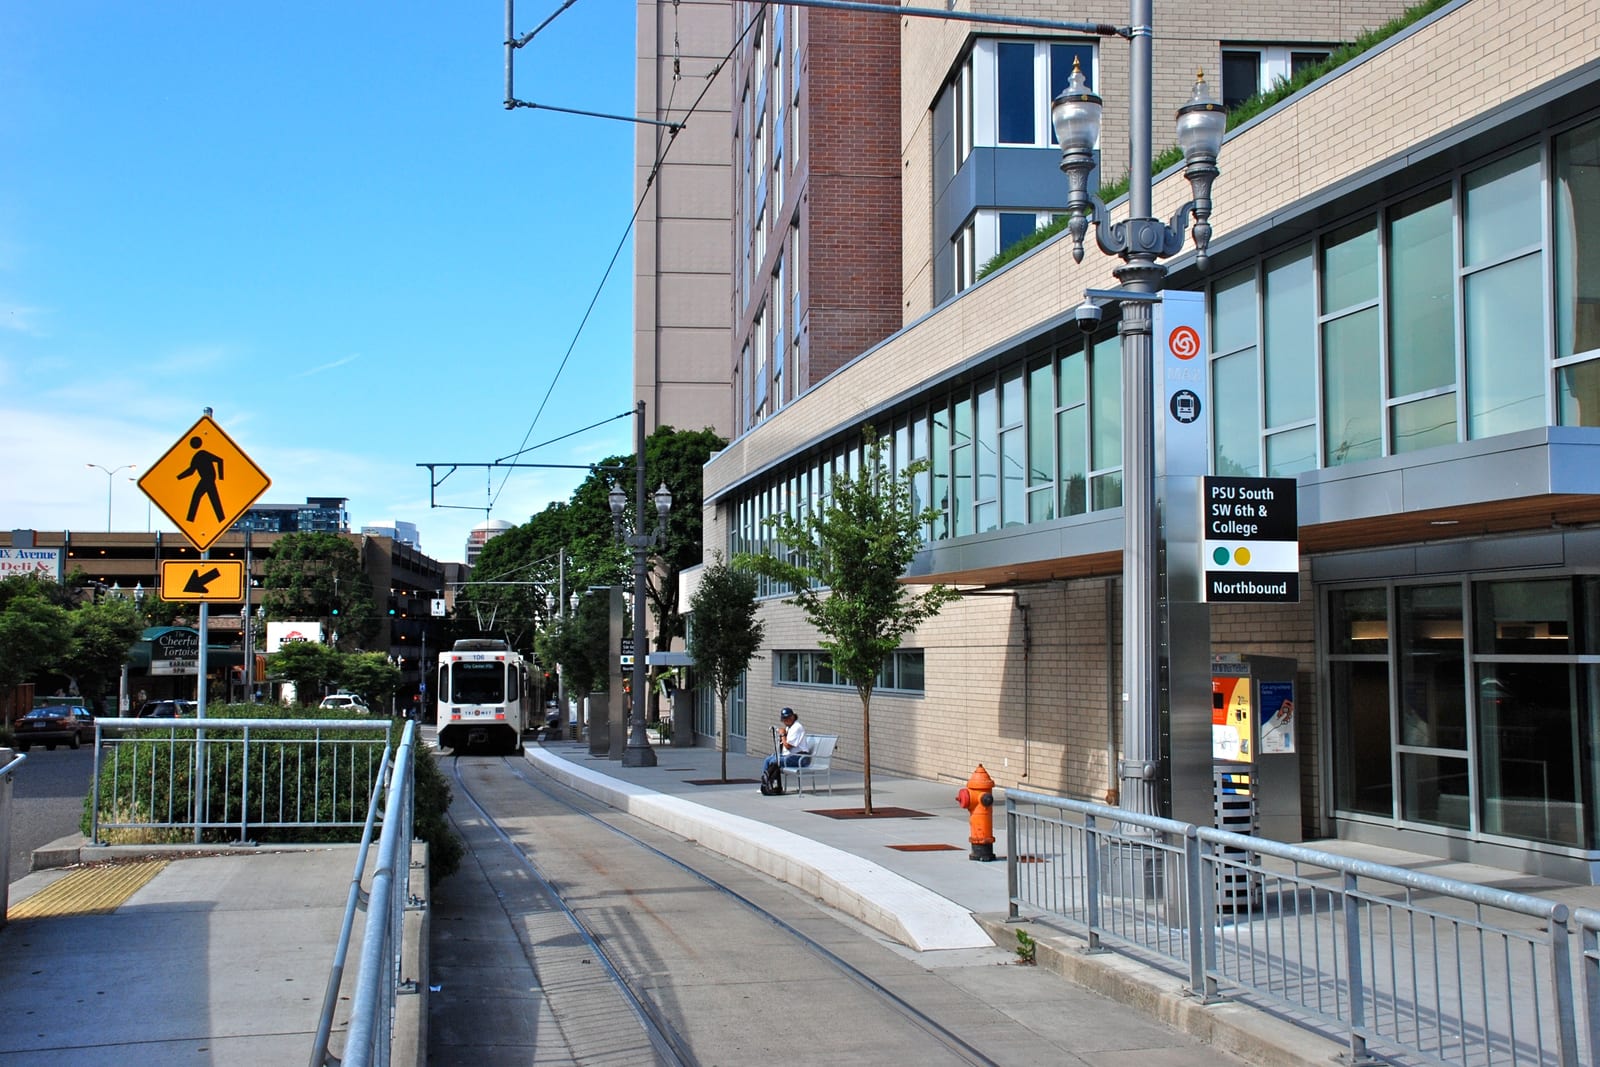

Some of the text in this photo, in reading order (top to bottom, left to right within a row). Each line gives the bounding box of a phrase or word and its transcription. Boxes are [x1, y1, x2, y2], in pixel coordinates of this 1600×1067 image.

[1212, 486, 1274, 500] PSU South
[1212, 503, 1268, 517] SW 6th &
[1212, 521, 1258, 537] College
[16, 549, 57, 559] Avenue
[1, 562, 32, 570] Deli
[1213, 581, 1287, 594] Northbound
[160, 635, 199, 647] Cheerful
[163, 646, 199, 657] Tortoise
